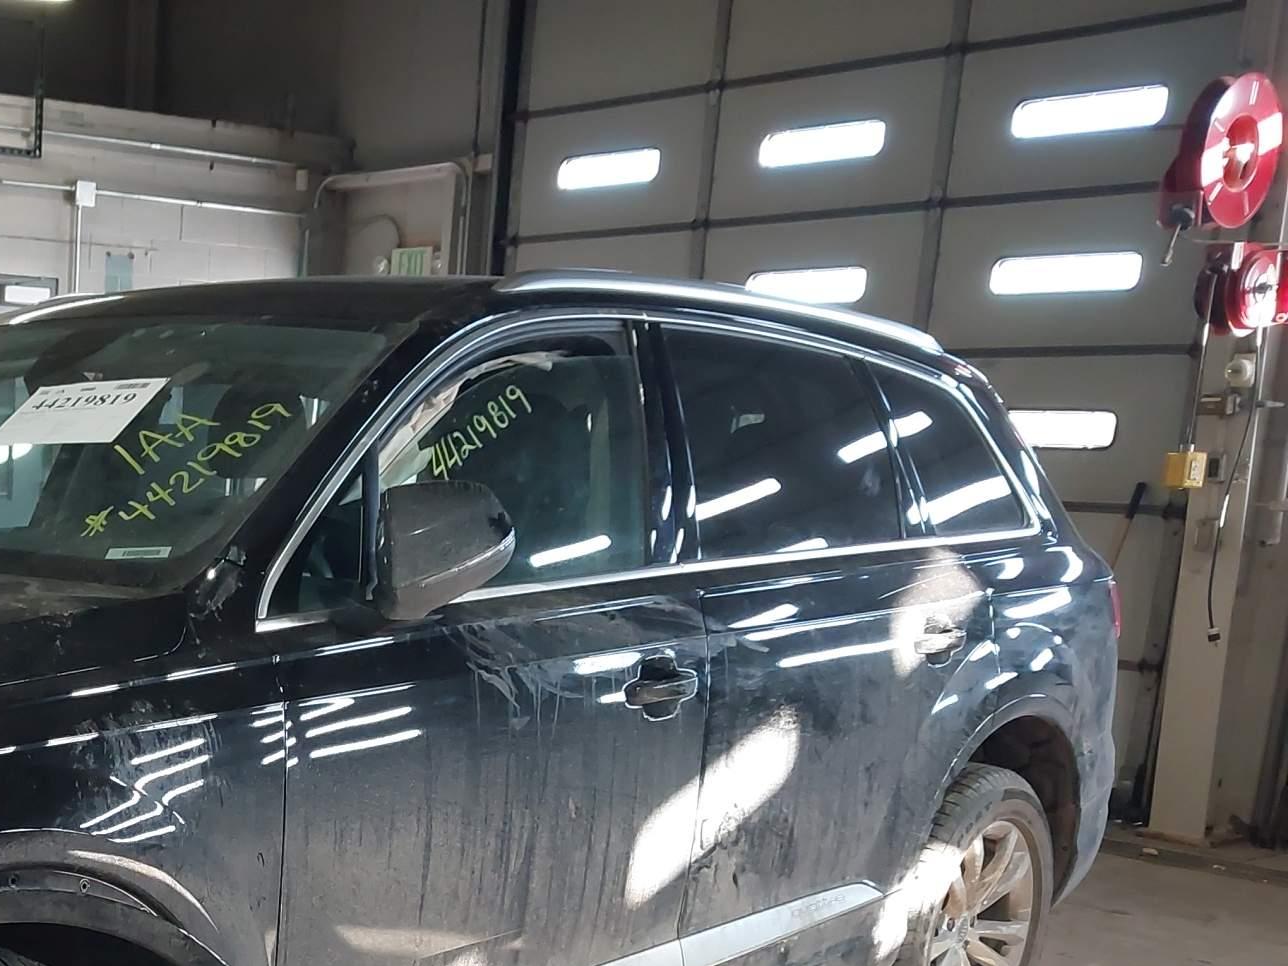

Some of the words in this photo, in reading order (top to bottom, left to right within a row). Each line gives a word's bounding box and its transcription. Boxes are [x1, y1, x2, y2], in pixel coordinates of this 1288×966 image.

[32, 392, 138, 411] 44219819
[431, 385, 533, 480] 44219819
[114, 413, 220, 475] IAA
